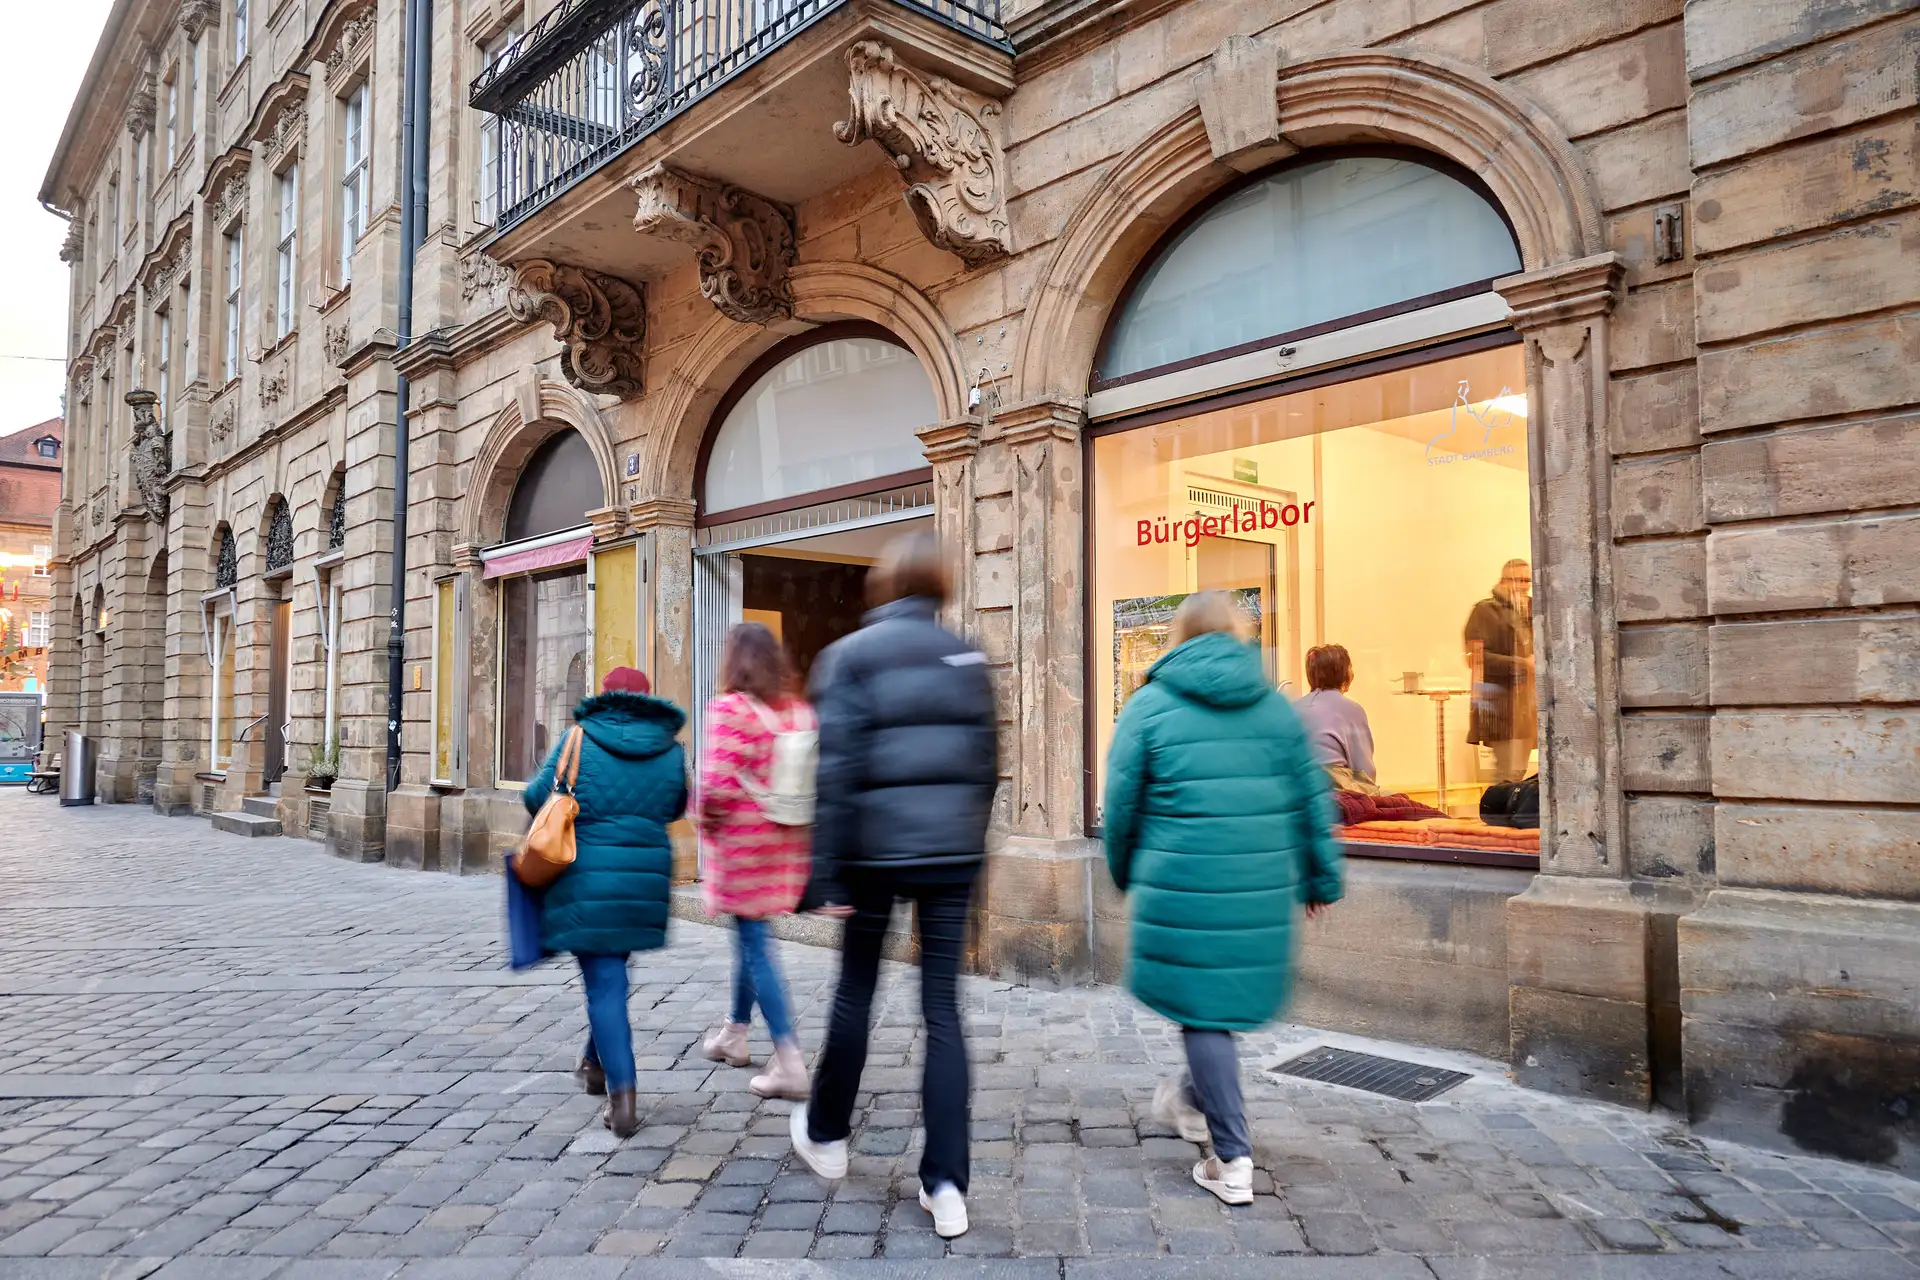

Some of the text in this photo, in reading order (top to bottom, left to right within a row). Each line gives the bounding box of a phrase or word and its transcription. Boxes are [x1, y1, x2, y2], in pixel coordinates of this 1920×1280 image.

[629, 458, 634, 471] 3
[1427, 445, 1514, 466] STADT BAMBERG
[1137, 500, 1315, 547] Bürgerlabor
